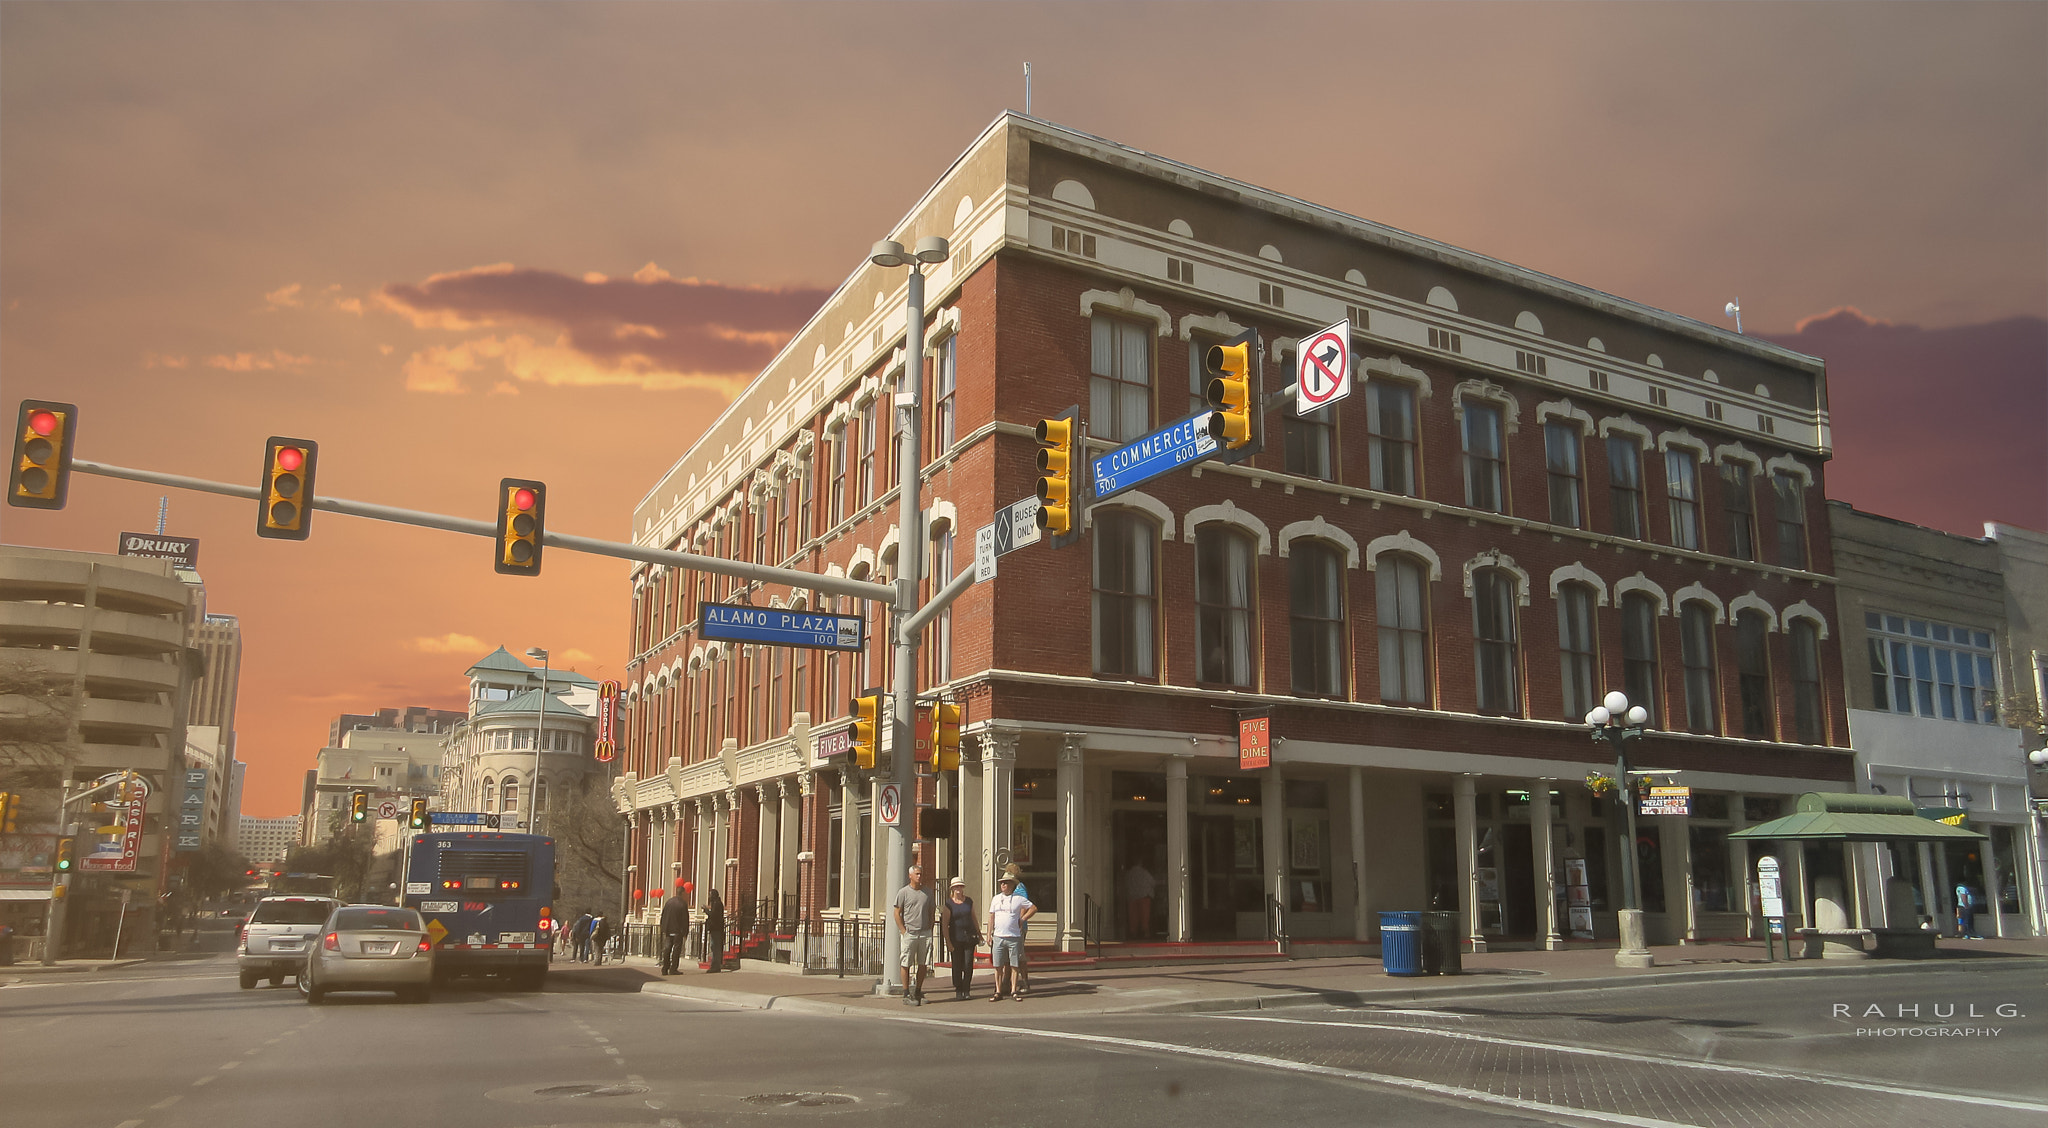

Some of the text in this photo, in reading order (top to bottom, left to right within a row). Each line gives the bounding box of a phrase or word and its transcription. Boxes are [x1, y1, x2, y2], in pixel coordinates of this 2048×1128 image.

[1096, 461, 1104, 478] E
[1112, 422, 1193, 471] COMMERCE
[1100, 477, 1117, 494] 500
[1175, 445, 1194, 463] 600
[1015, 504, 1037, 522] BUSES
[981, 529, 992, 542] NO
[1017, 522, 1035, 539] ONLY
[125, 536, 191, 554] DRURY
[980, 543, 992, 555] TURN
[981, 555, 990, 565] ON
[980, 566, 991, 577] RED
[707, 608, 836, 632] ALAMO PLAZA
[814, 634, 834, 645] 100
[1242, 721, 1265, 732] FIVE
[820, 737, 838, 755] FIVE
[838, 735, 845, 750] &
[1251, 735, 1258, 744] &
[1242, 746, 1268, 758] DIME
[178, 772, 205, 847] PARK
[124, 790, 143, 858] CASA RIO
[437, 841, 452, 849] 363
[114, 858, 134, 870] food
[463, 901, 486, 911] VIA
